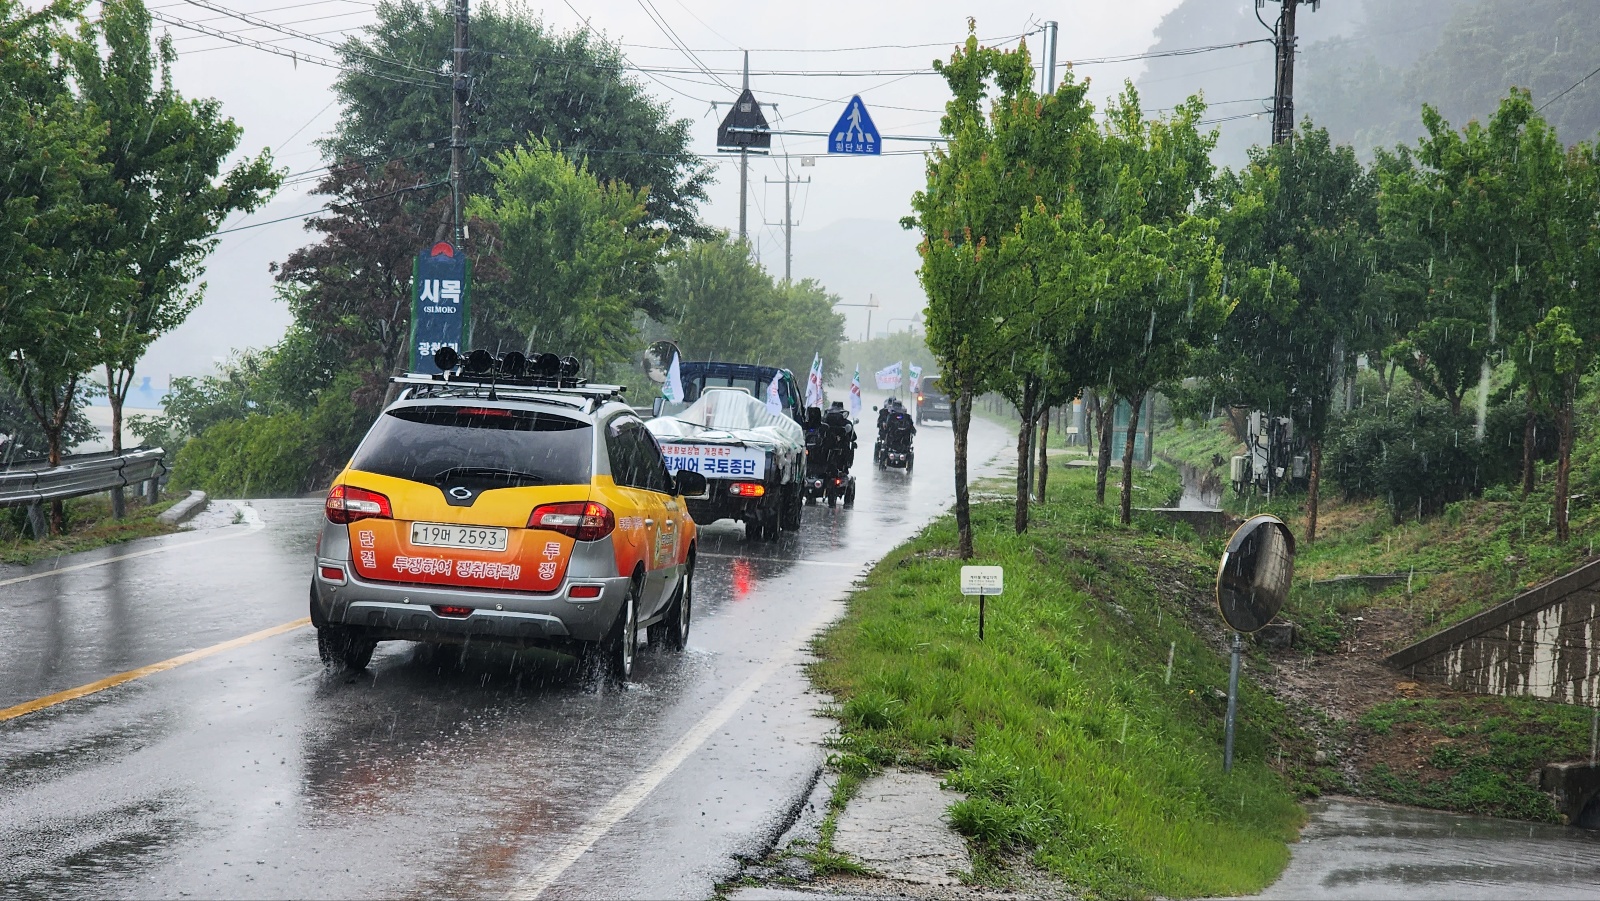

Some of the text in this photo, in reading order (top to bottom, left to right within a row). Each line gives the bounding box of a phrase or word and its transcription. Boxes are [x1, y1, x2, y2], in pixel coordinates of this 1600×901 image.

[836, 143, 874, 152] 횡단보도
[419, 279, 462, 304] 시목
[660, 445, 700, 456] 초생활보장법
[703, 458, 757, 475] 국토종단
[422, 526, 497, 546] 19머 2593
[392, 556, 521, 581] 투쟁하여 쟁취하라!
